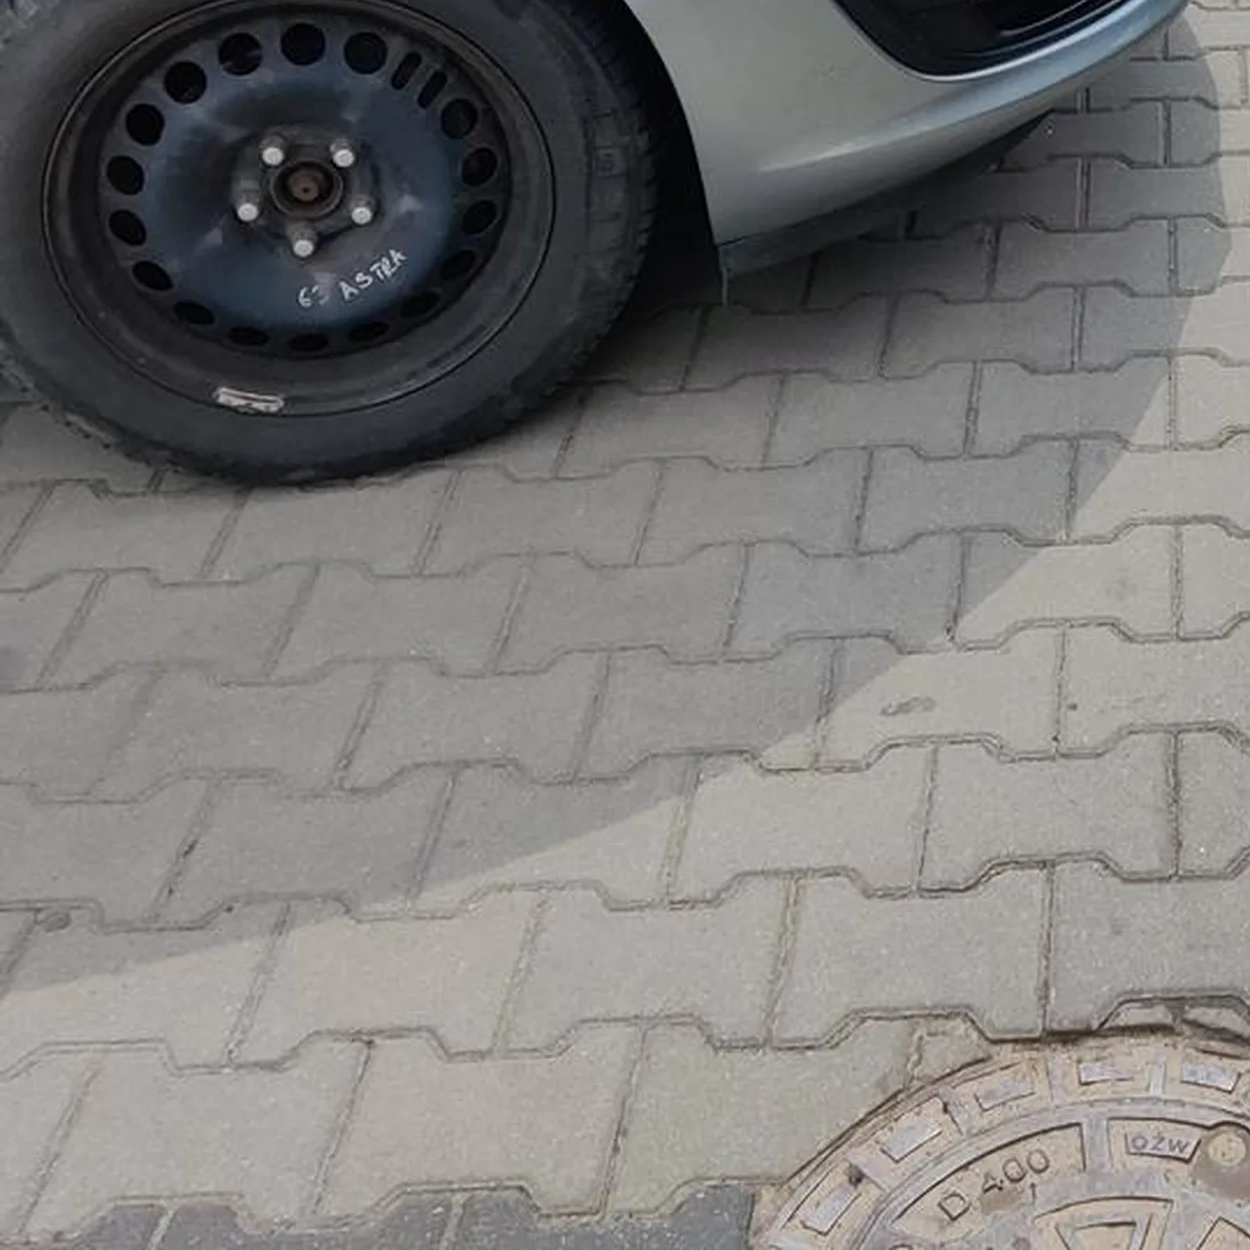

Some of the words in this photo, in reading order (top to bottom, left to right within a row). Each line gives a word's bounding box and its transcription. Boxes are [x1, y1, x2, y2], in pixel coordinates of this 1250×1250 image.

[338, 249, 408, 301] ASTRA
[937, 1191, 972, 1221] D
[982, 1149, 1050, 1194] 400
